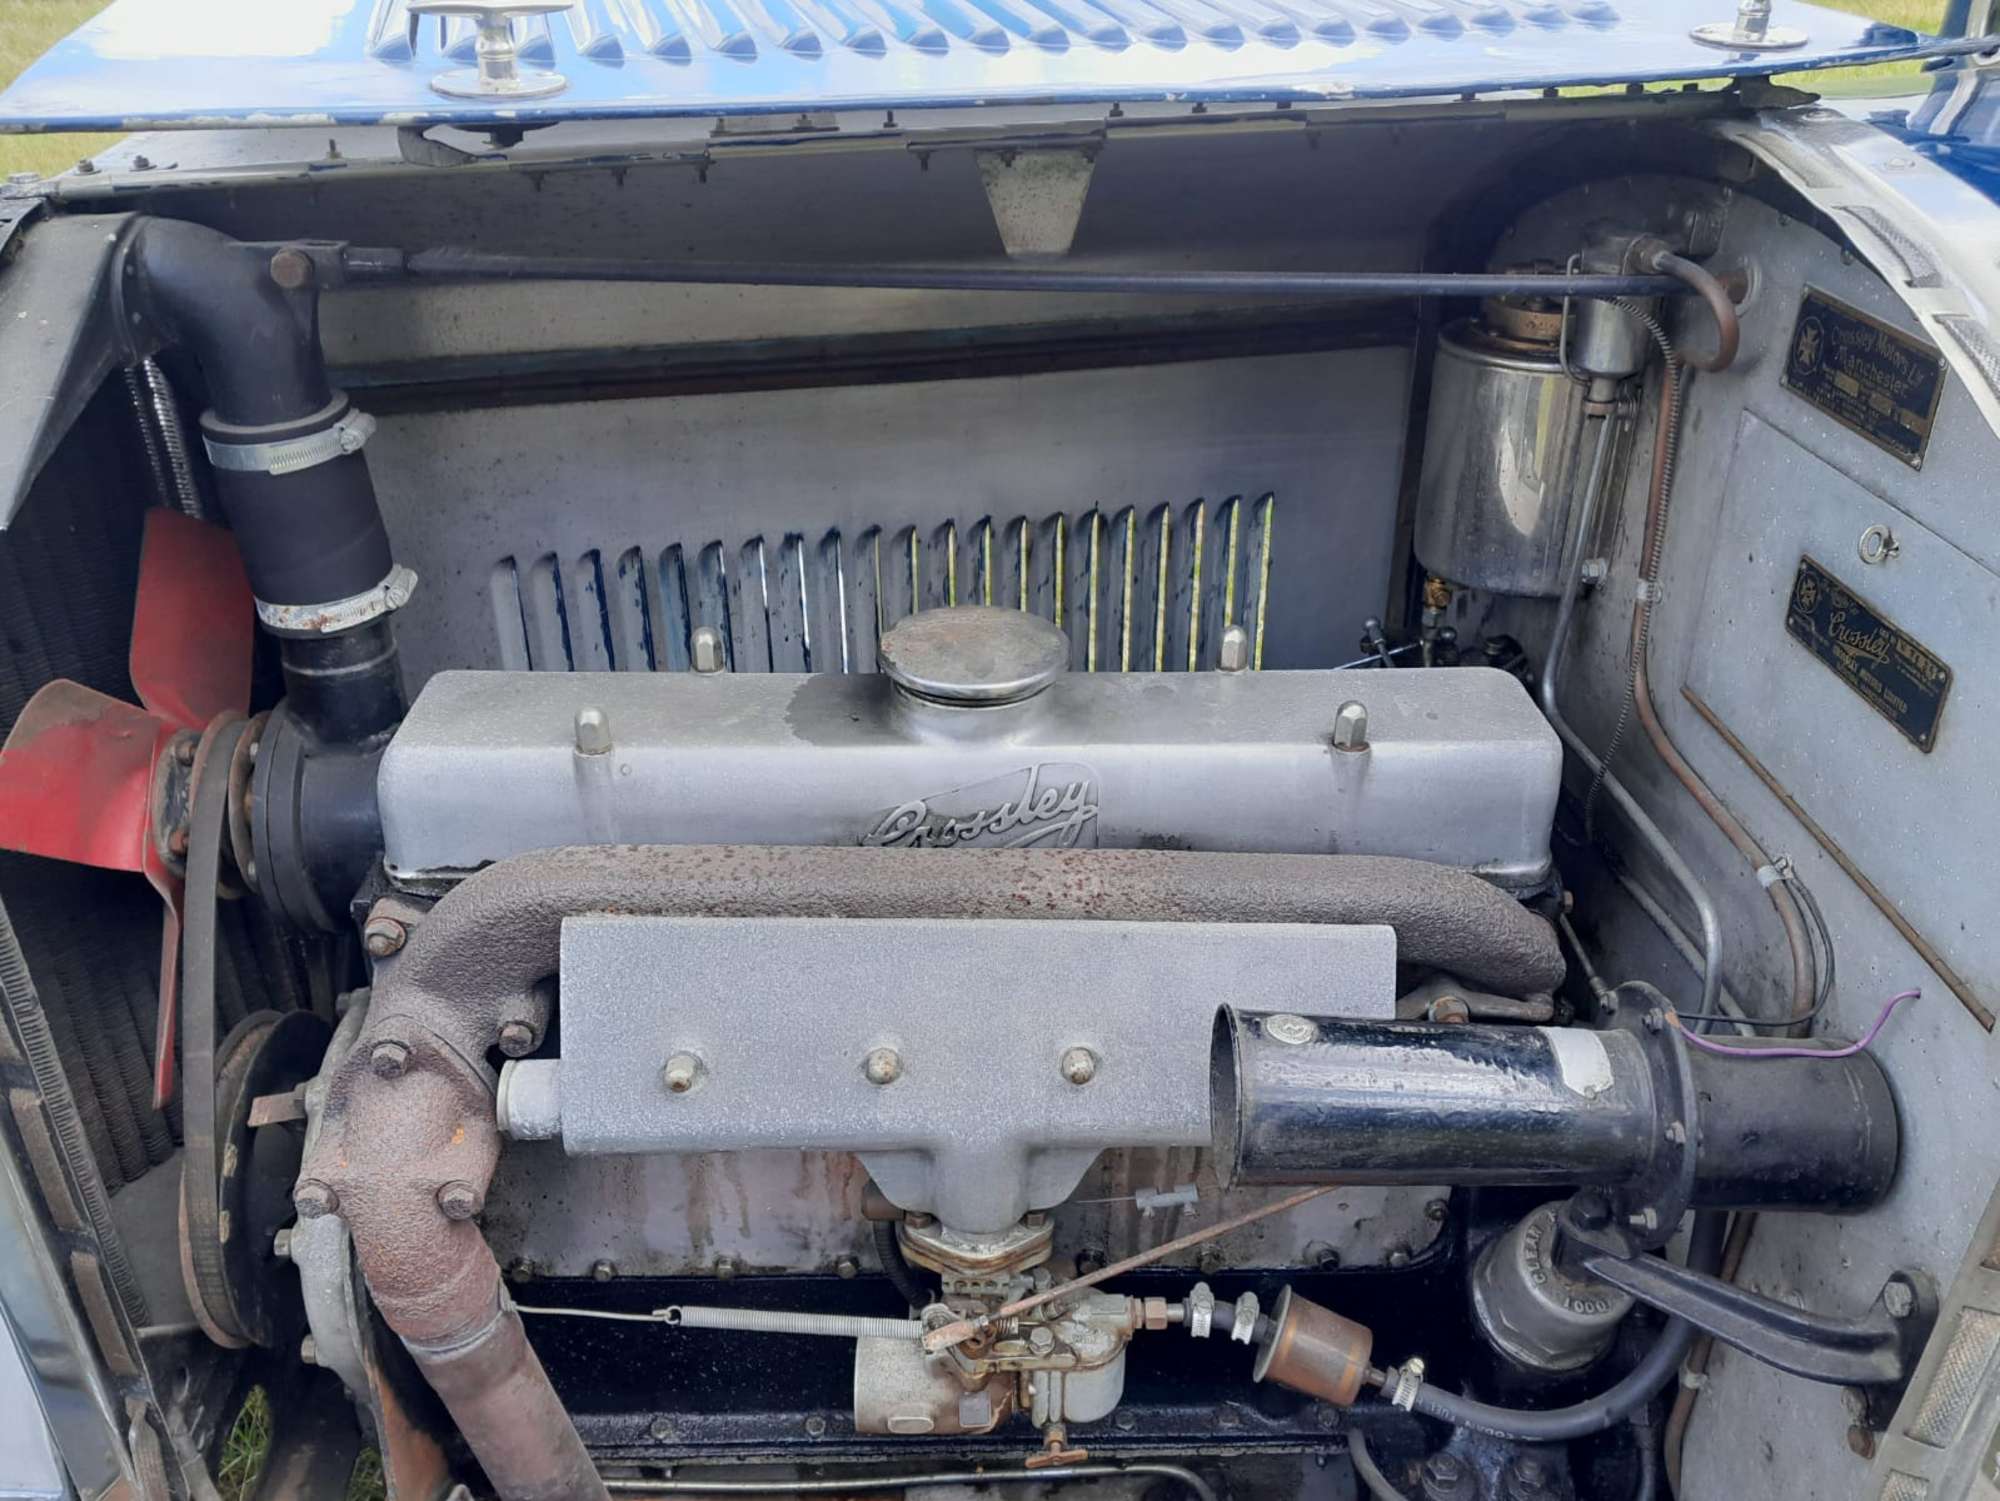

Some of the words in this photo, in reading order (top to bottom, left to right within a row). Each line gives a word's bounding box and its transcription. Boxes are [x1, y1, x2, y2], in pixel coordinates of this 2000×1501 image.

[861, 762, 1100, 849] Crossley
[1524, 1224, 1548, 1286] CLEAN
[1563, 1297, 1609, 1314] 1000
